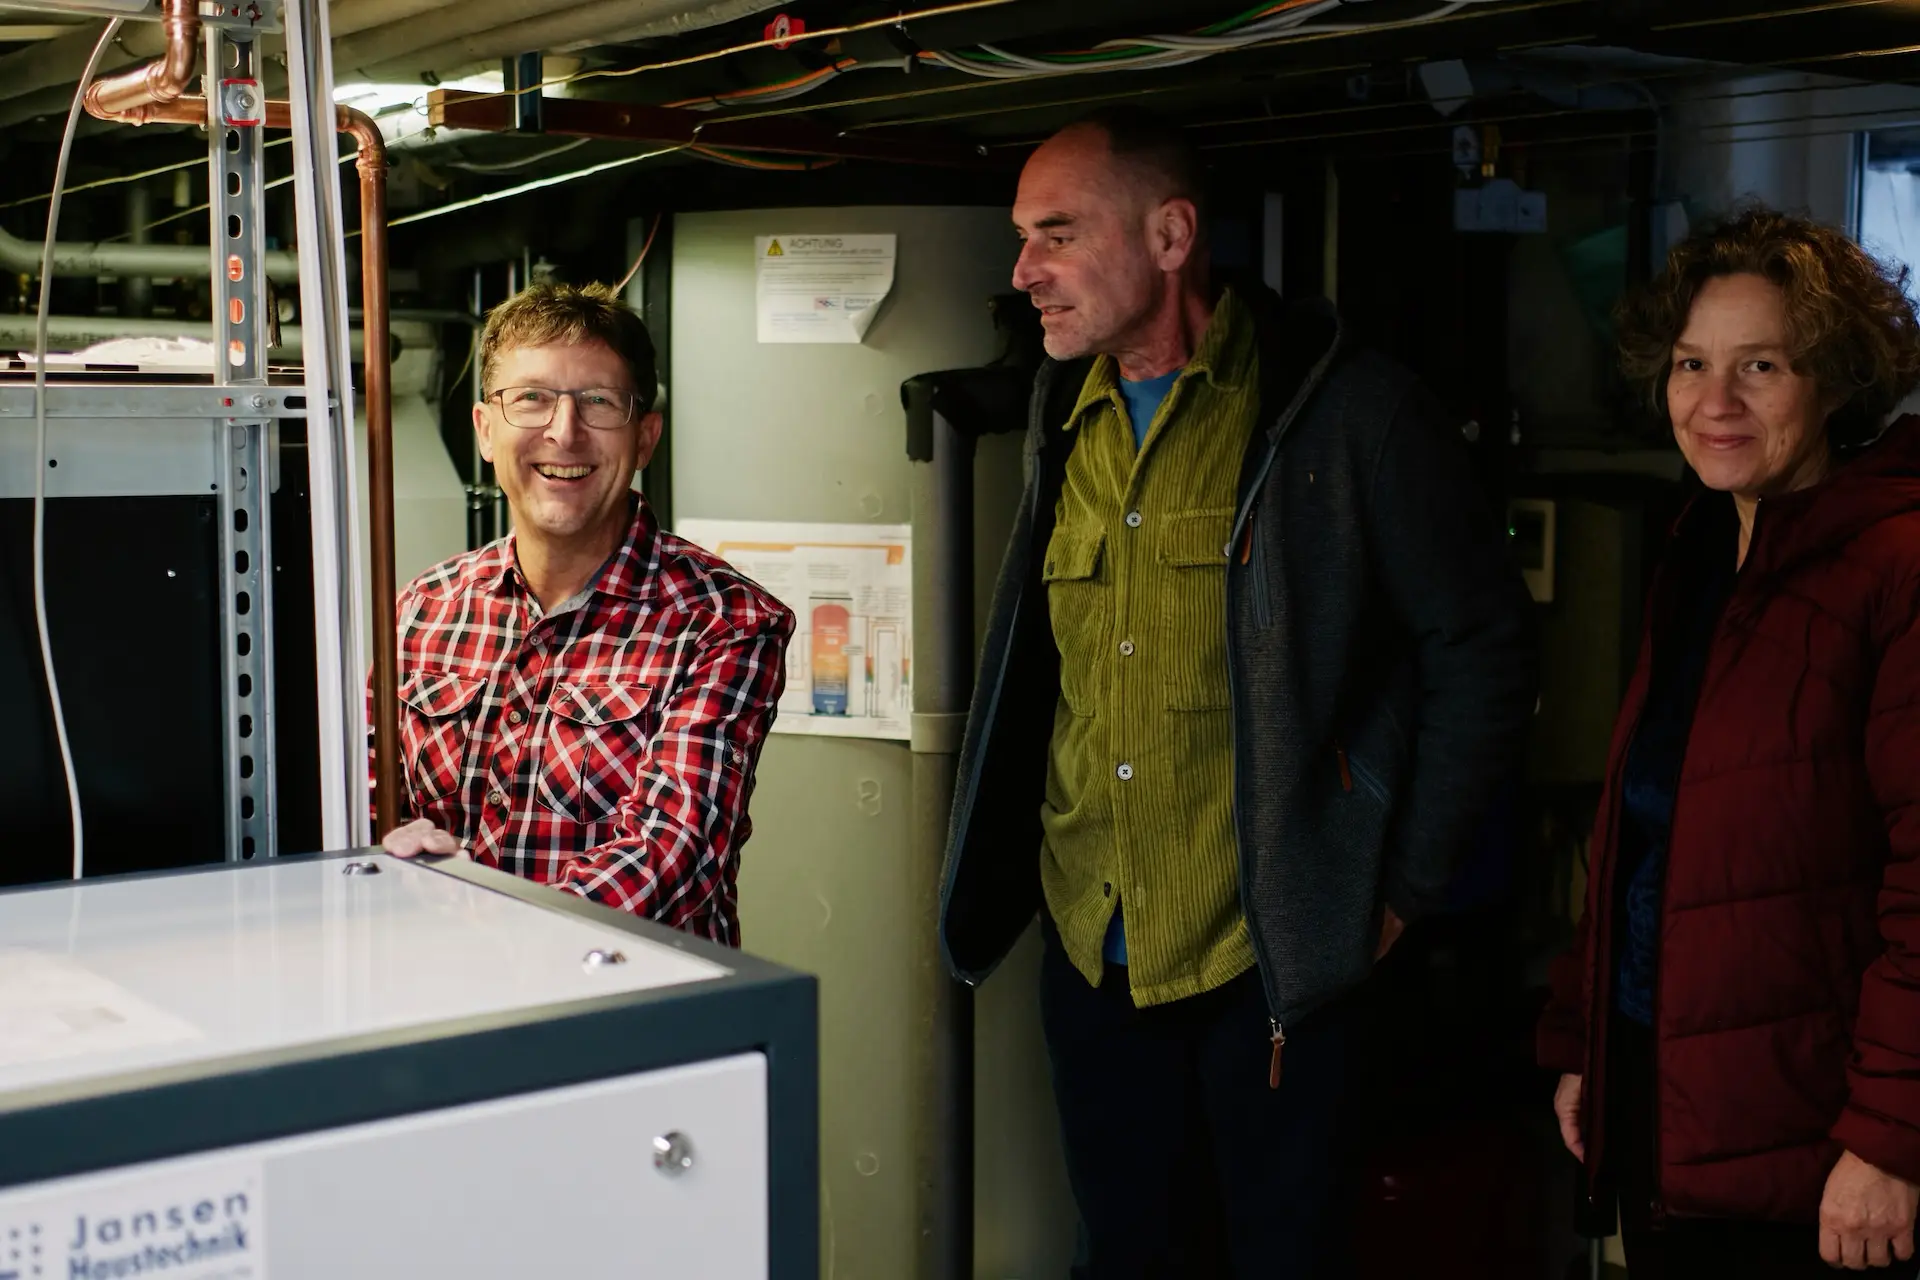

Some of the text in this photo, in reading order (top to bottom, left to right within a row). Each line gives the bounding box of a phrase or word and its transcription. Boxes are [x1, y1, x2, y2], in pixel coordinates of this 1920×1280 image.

[790, 237, 844, 249] ACHTUNG
[69, 1192, 249, 1250] Jansen
[67, 1222, 248, 1280] Haustechnik
